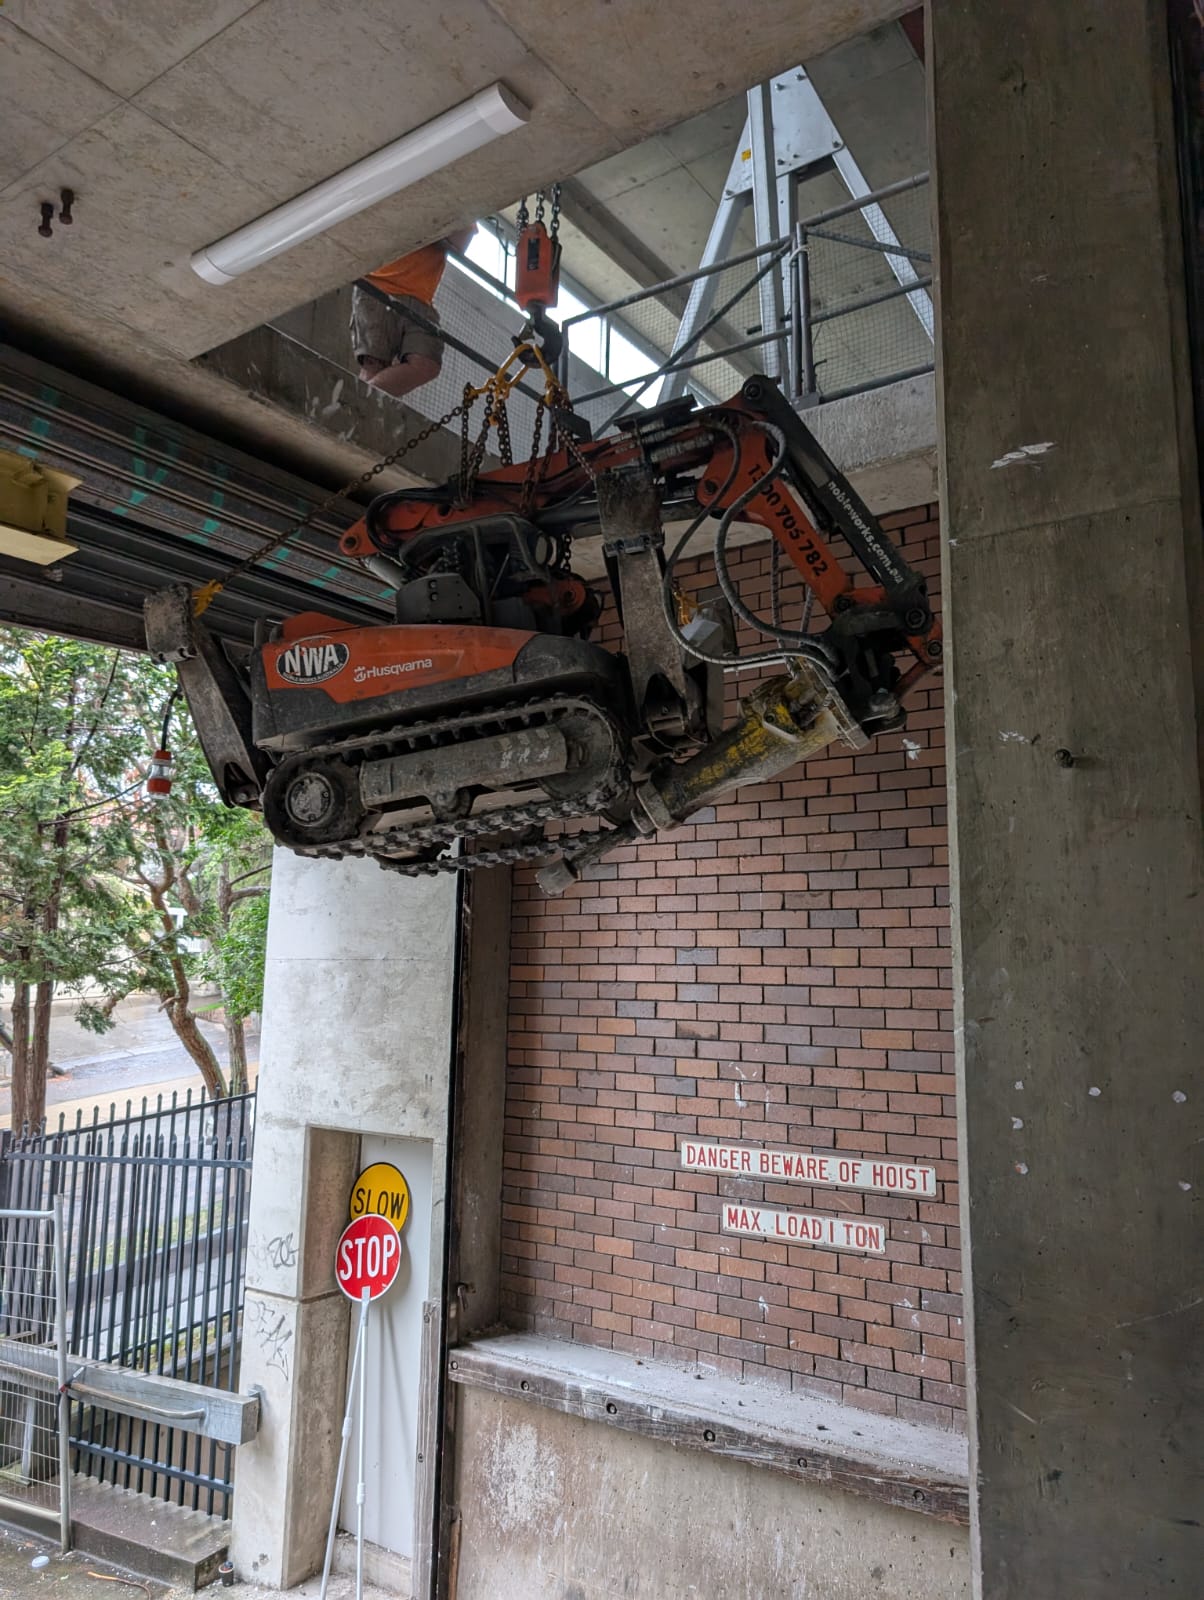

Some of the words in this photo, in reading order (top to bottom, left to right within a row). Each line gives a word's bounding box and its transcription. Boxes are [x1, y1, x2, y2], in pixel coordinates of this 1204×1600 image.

[775, 504, 805, 540] 705
[797, 539, 828, 577] 782
[284, 644, 339, 677] NWA
[366, 658, 433, 679] Husqvarna
[686, 1144, 751, 1172] DANGER
[759, 1152, 829, 1181] BEWARE
[839, 1161, 862, 1183] OF
[872, 1164, 930, 1192] HOIST
[353, 1187, 405, 1220] SLOW
[775, 1213, 823, 1241] LOAD
[842, 1222, 880, 1250] TON
[339, 1233, 396, 1281] STOP
